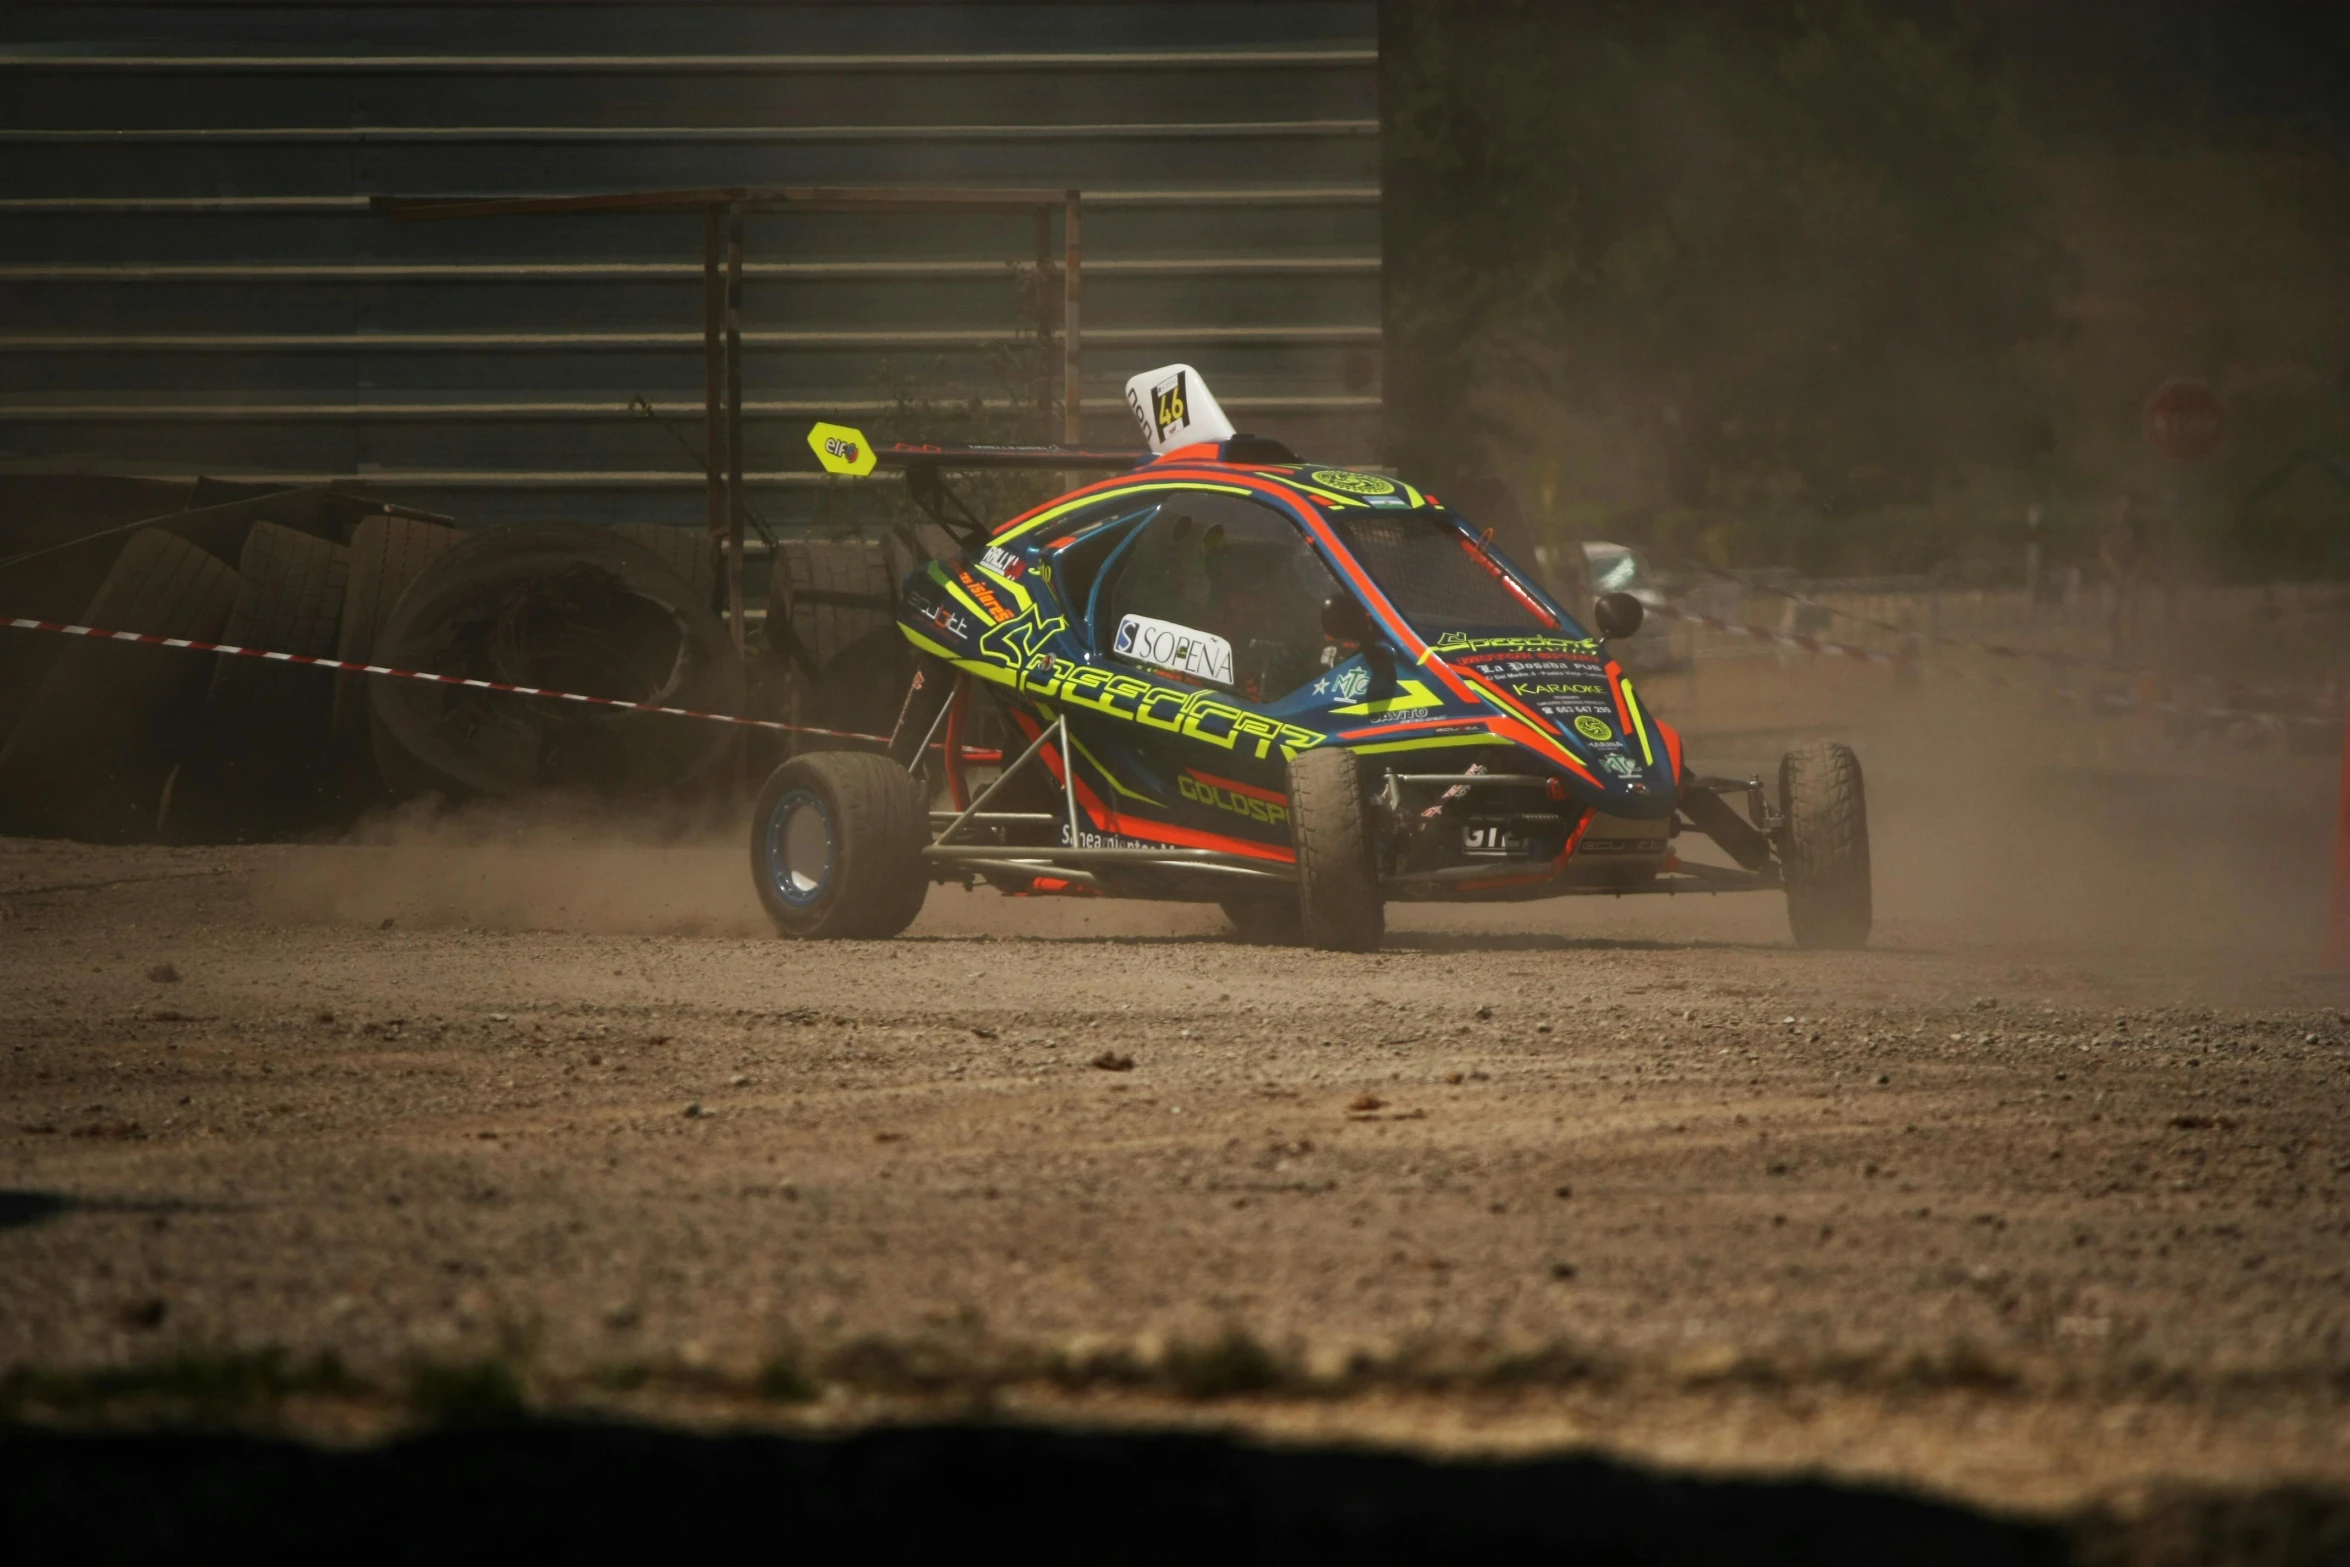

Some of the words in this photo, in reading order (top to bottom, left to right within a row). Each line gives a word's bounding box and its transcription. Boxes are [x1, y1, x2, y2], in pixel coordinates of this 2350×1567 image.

[1159, 386, 1184, 425] 46
[824, 437, 847, 458] elf
[1139, 627, 1233, 683] SOPEÑA
[1573, 663, 1601, 672] PUB
[1512, 683, 1608, 696] KARAOKE
[1177, 775, 1290, 825] GOLDSP
